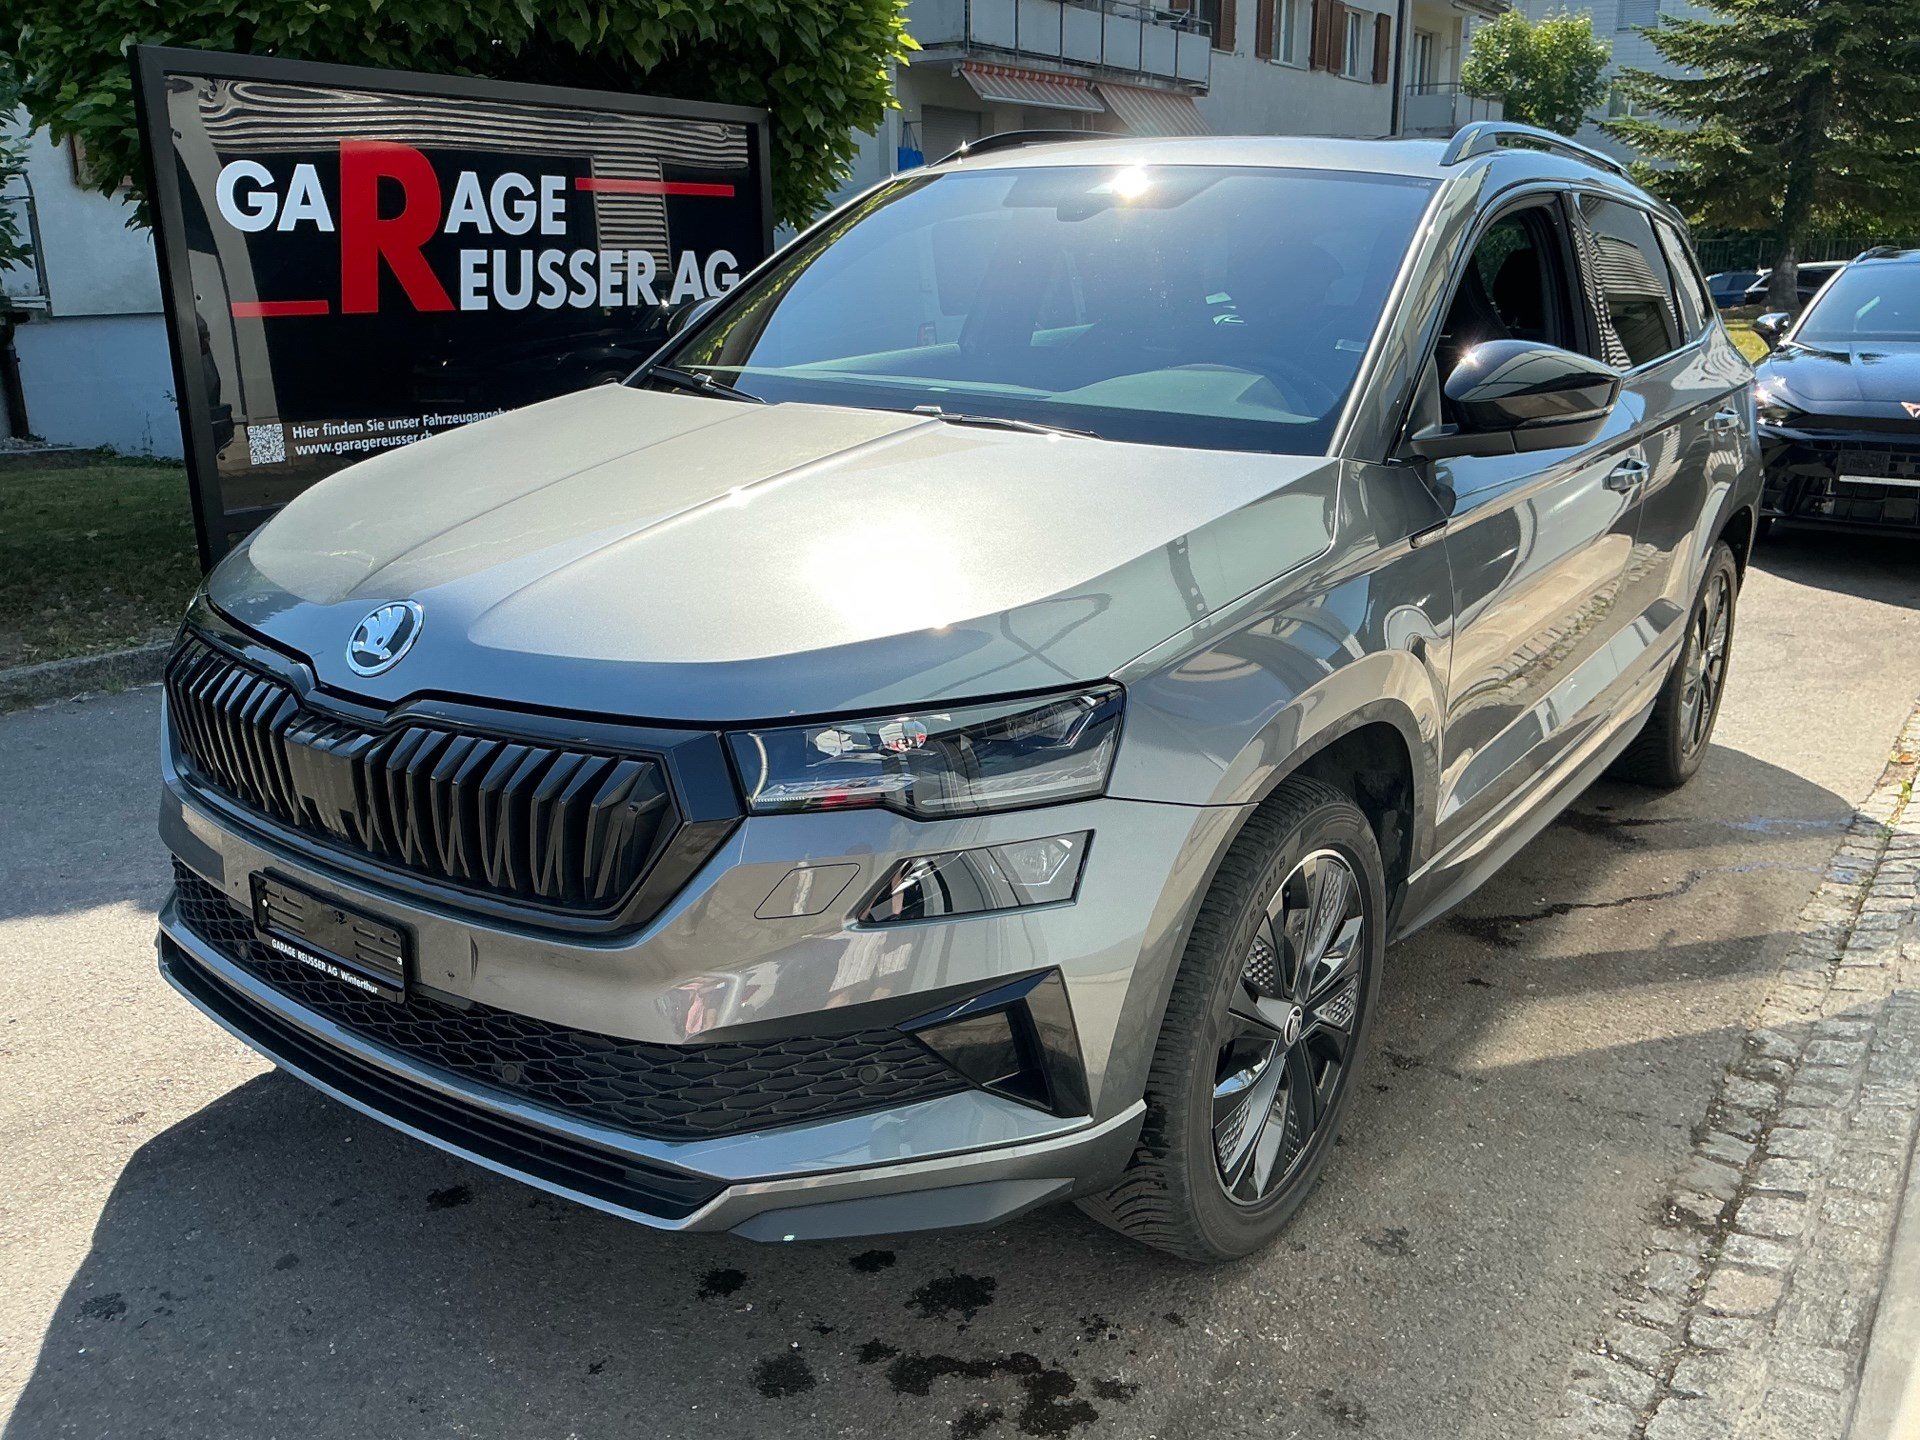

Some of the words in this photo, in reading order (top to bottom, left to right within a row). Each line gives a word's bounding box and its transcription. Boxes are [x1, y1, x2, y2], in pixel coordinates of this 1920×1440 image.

[215, 140, 567, 314] GARAGE
[670, 250, 740, 304] AG
[292, 425, 319, 439] Hier
[322, 422, 364, 436] finden
[367, 419, 385, 432] Sie
[388, 417, 421, 430] unser
[271, 938, 296, 958] GARAGE
[297, 950, 326, 973] REUSSER
[327, 964, 338, 977] AG
[340, 969, 379, 994] Winterthur
